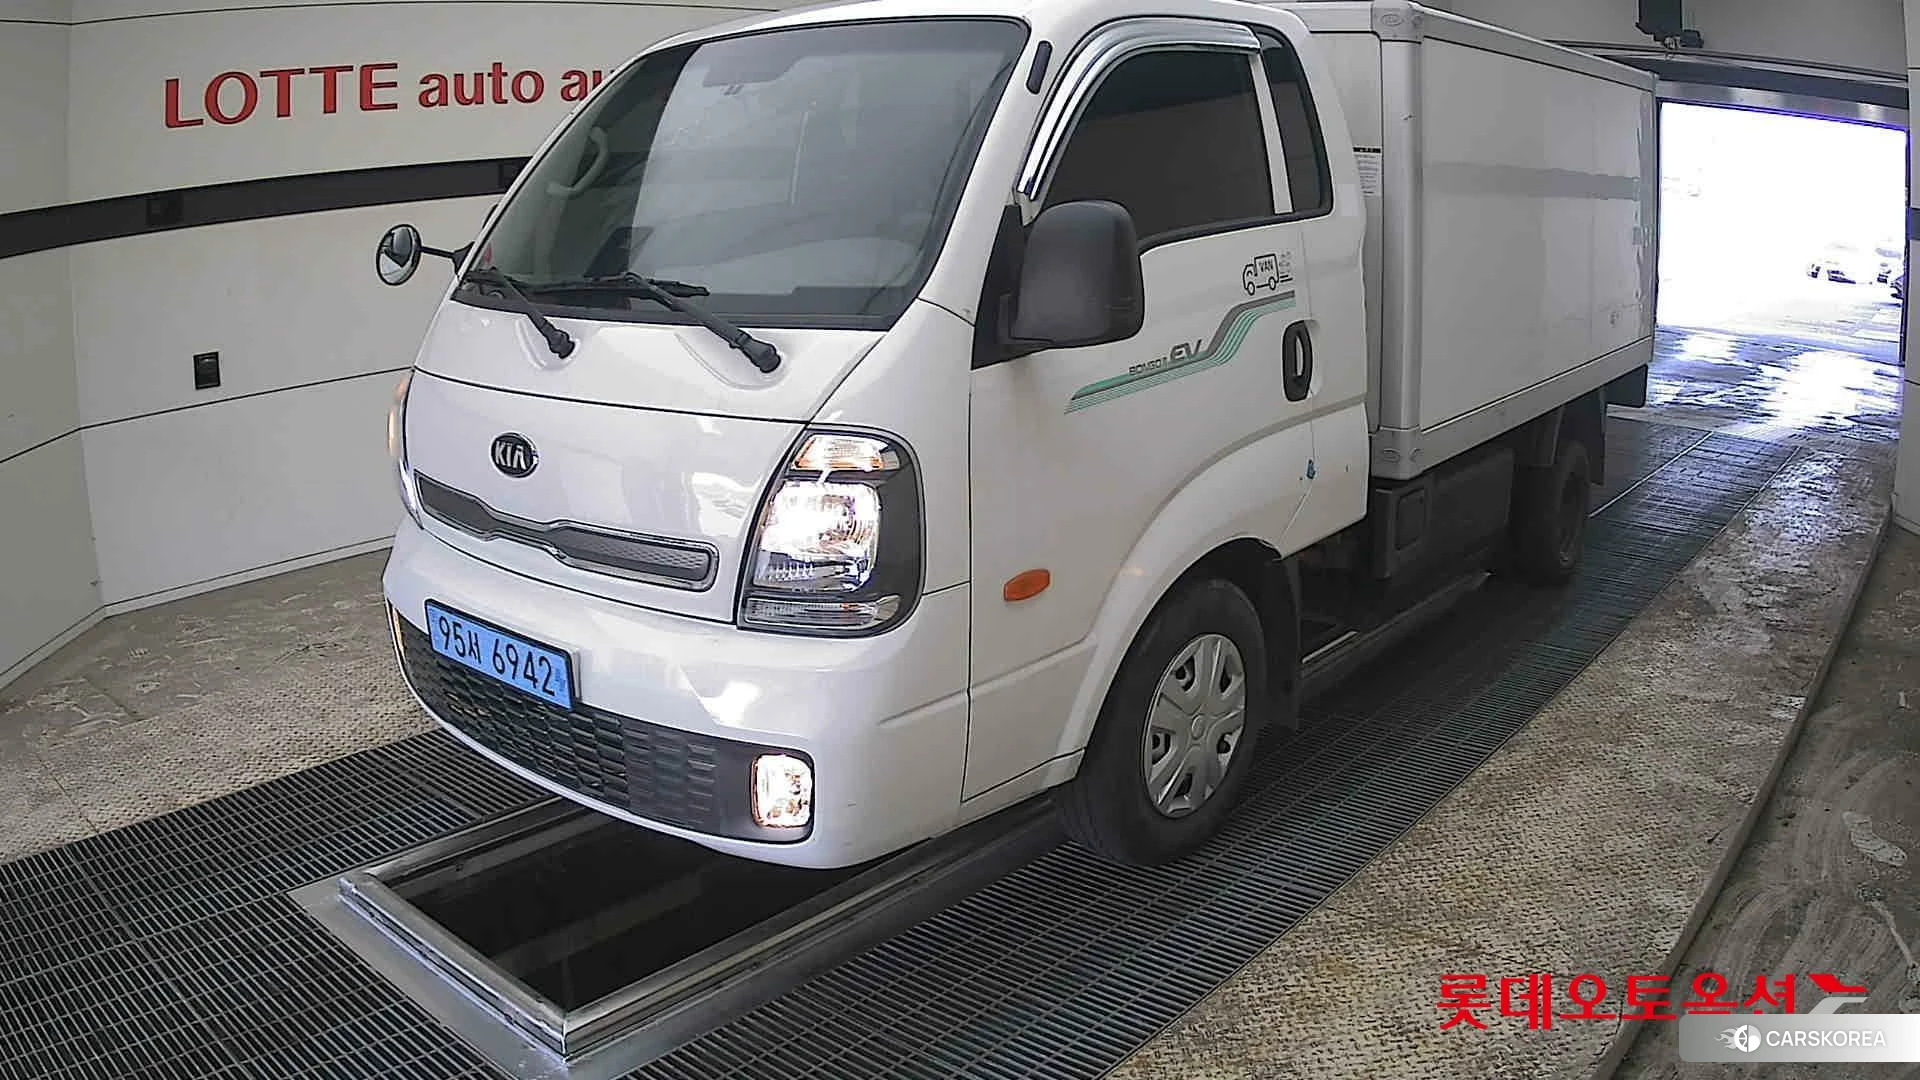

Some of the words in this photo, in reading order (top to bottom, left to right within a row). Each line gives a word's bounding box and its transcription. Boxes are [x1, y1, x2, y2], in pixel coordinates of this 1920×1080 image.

[165, 63, 398, 128] LOTTE
[418, 62, 545, 108] auto
[1169, 339, 1202, 361] EV
[495, 440, 527, 470] KIA
[439, 616, 482, 664] 95서
[492, 639, 555, 696] 6942
